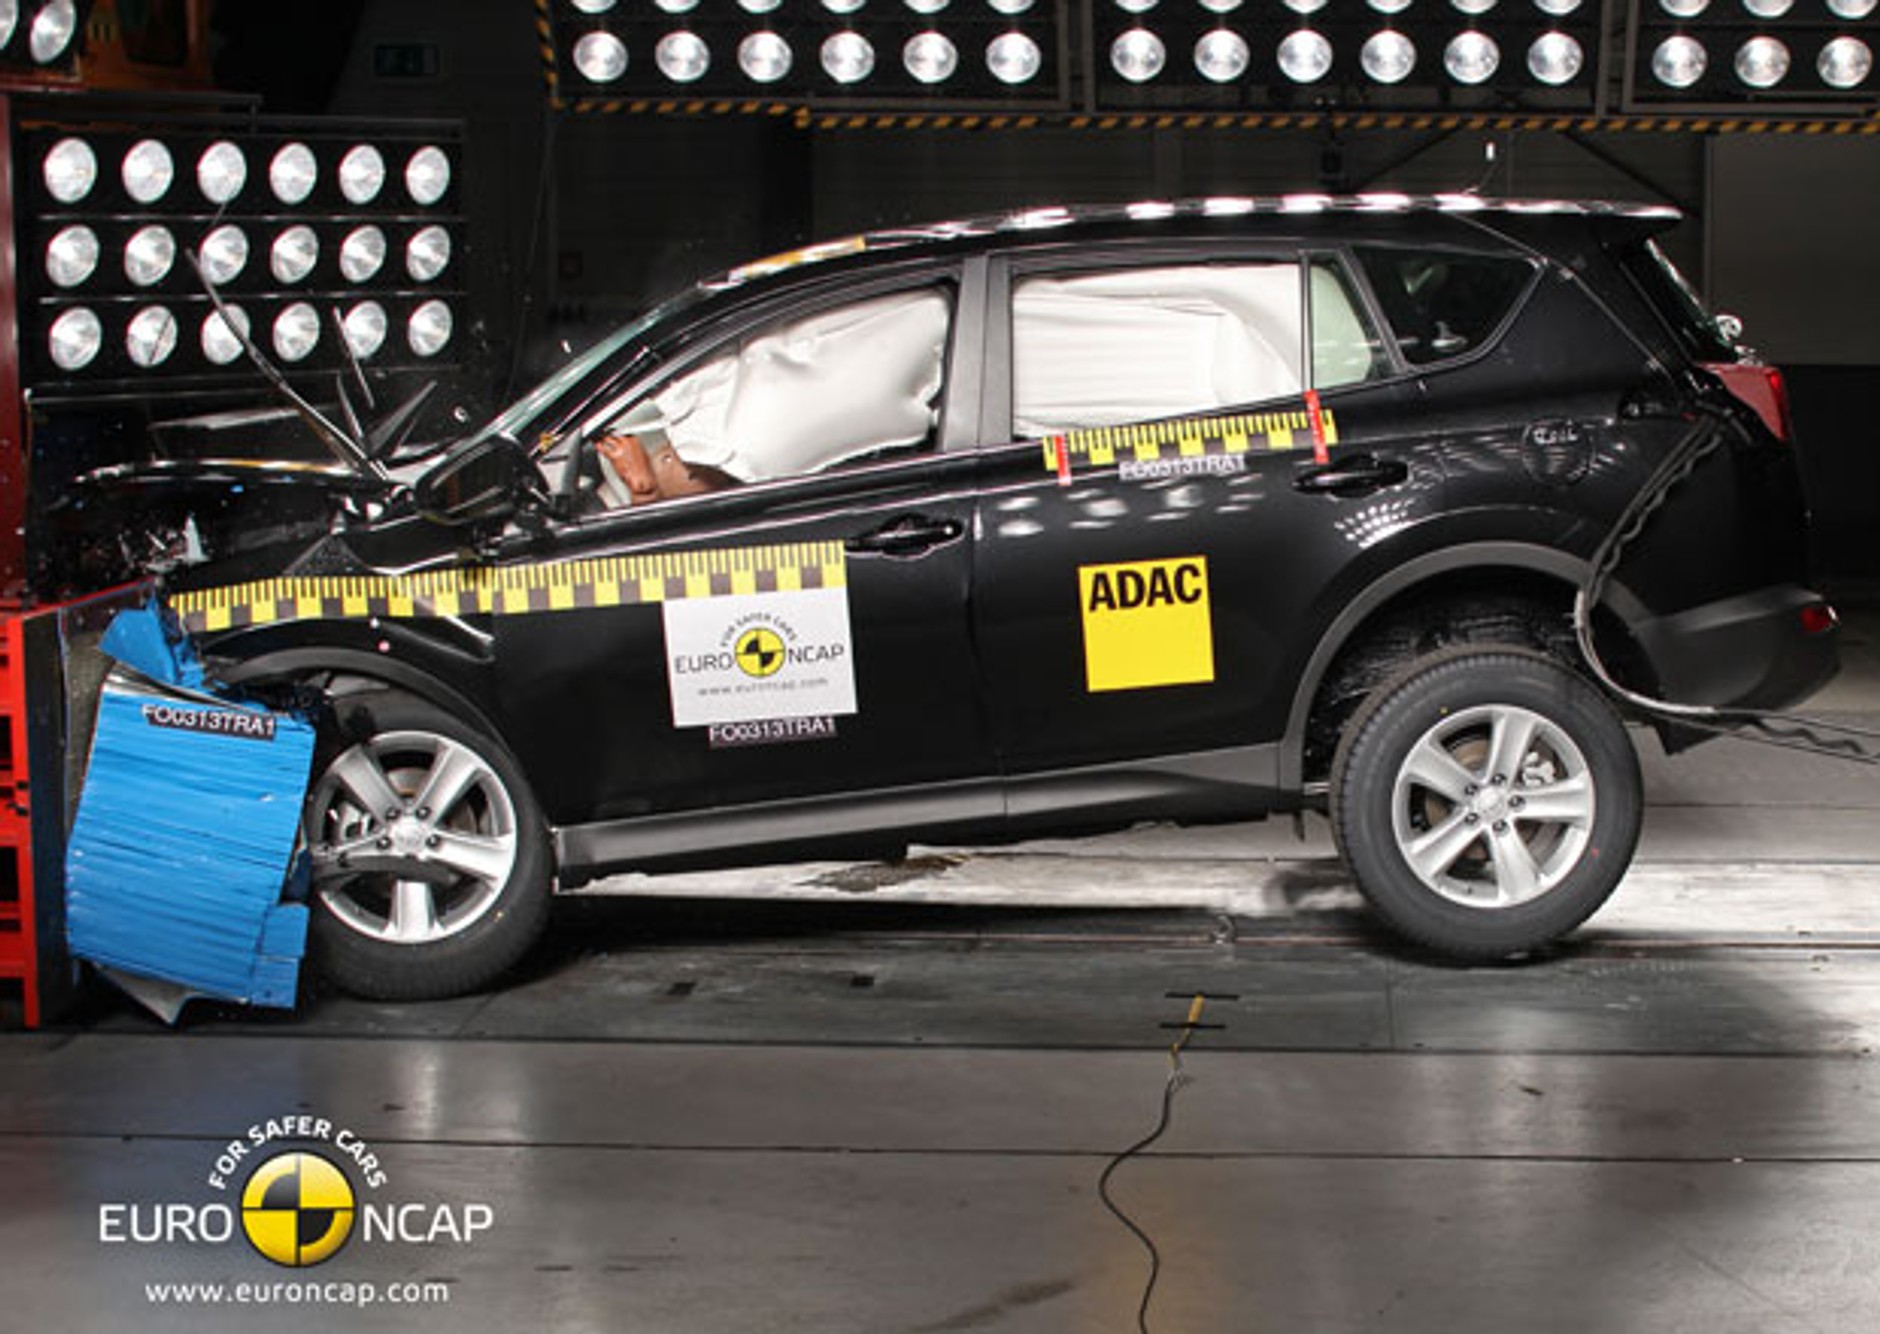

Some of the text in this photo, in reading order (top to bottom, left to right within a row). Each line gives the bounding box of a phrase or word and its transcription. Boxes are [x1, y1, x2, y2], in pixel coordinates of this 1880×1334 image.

[1089, 564, 1202, 612] ADAC
[675, 643, 844, 674] EURO NCAP
